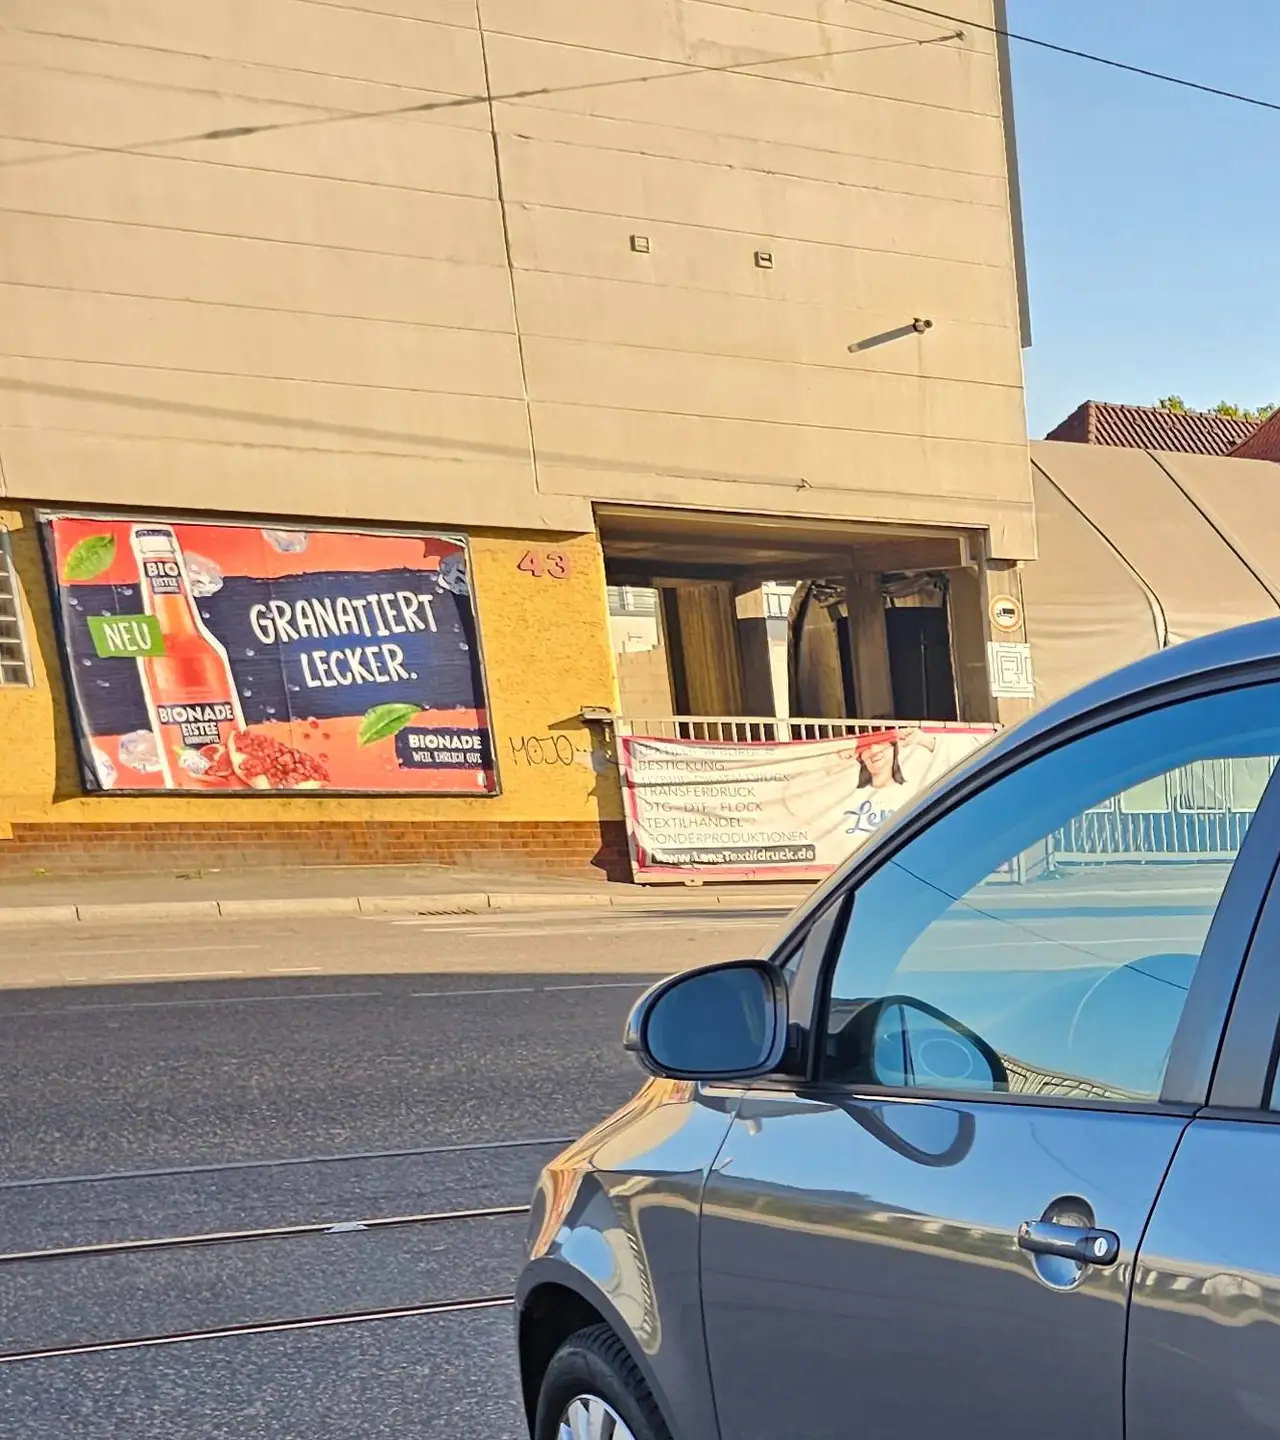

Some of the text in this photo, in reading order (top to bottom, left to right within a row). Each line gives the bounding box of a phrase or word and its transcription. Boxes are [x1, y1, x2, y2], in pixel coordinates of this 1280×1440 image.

[516, 550, 570, 579] 43
[250, 591, 437, 644] GRANATIERT
[102, 621, 152, 652] NEU
[301, 643, 418, 688] LECKER.
[158, 704, 234, 723] BIONADE
[181, 722, 218, 737] EISTEE
[407, 734, 483, 750] BIONADE
[412, 751, 433, 763] WEIL
[638, 760, 726, 772] BESTICKUNG
[643, 786, 757, 798] TRANSFERDRUCK
[646, 816, 744, 829] TEXTILHANDEL
[648, 830, 808, 845] SONDERPRODUKTIONEN
